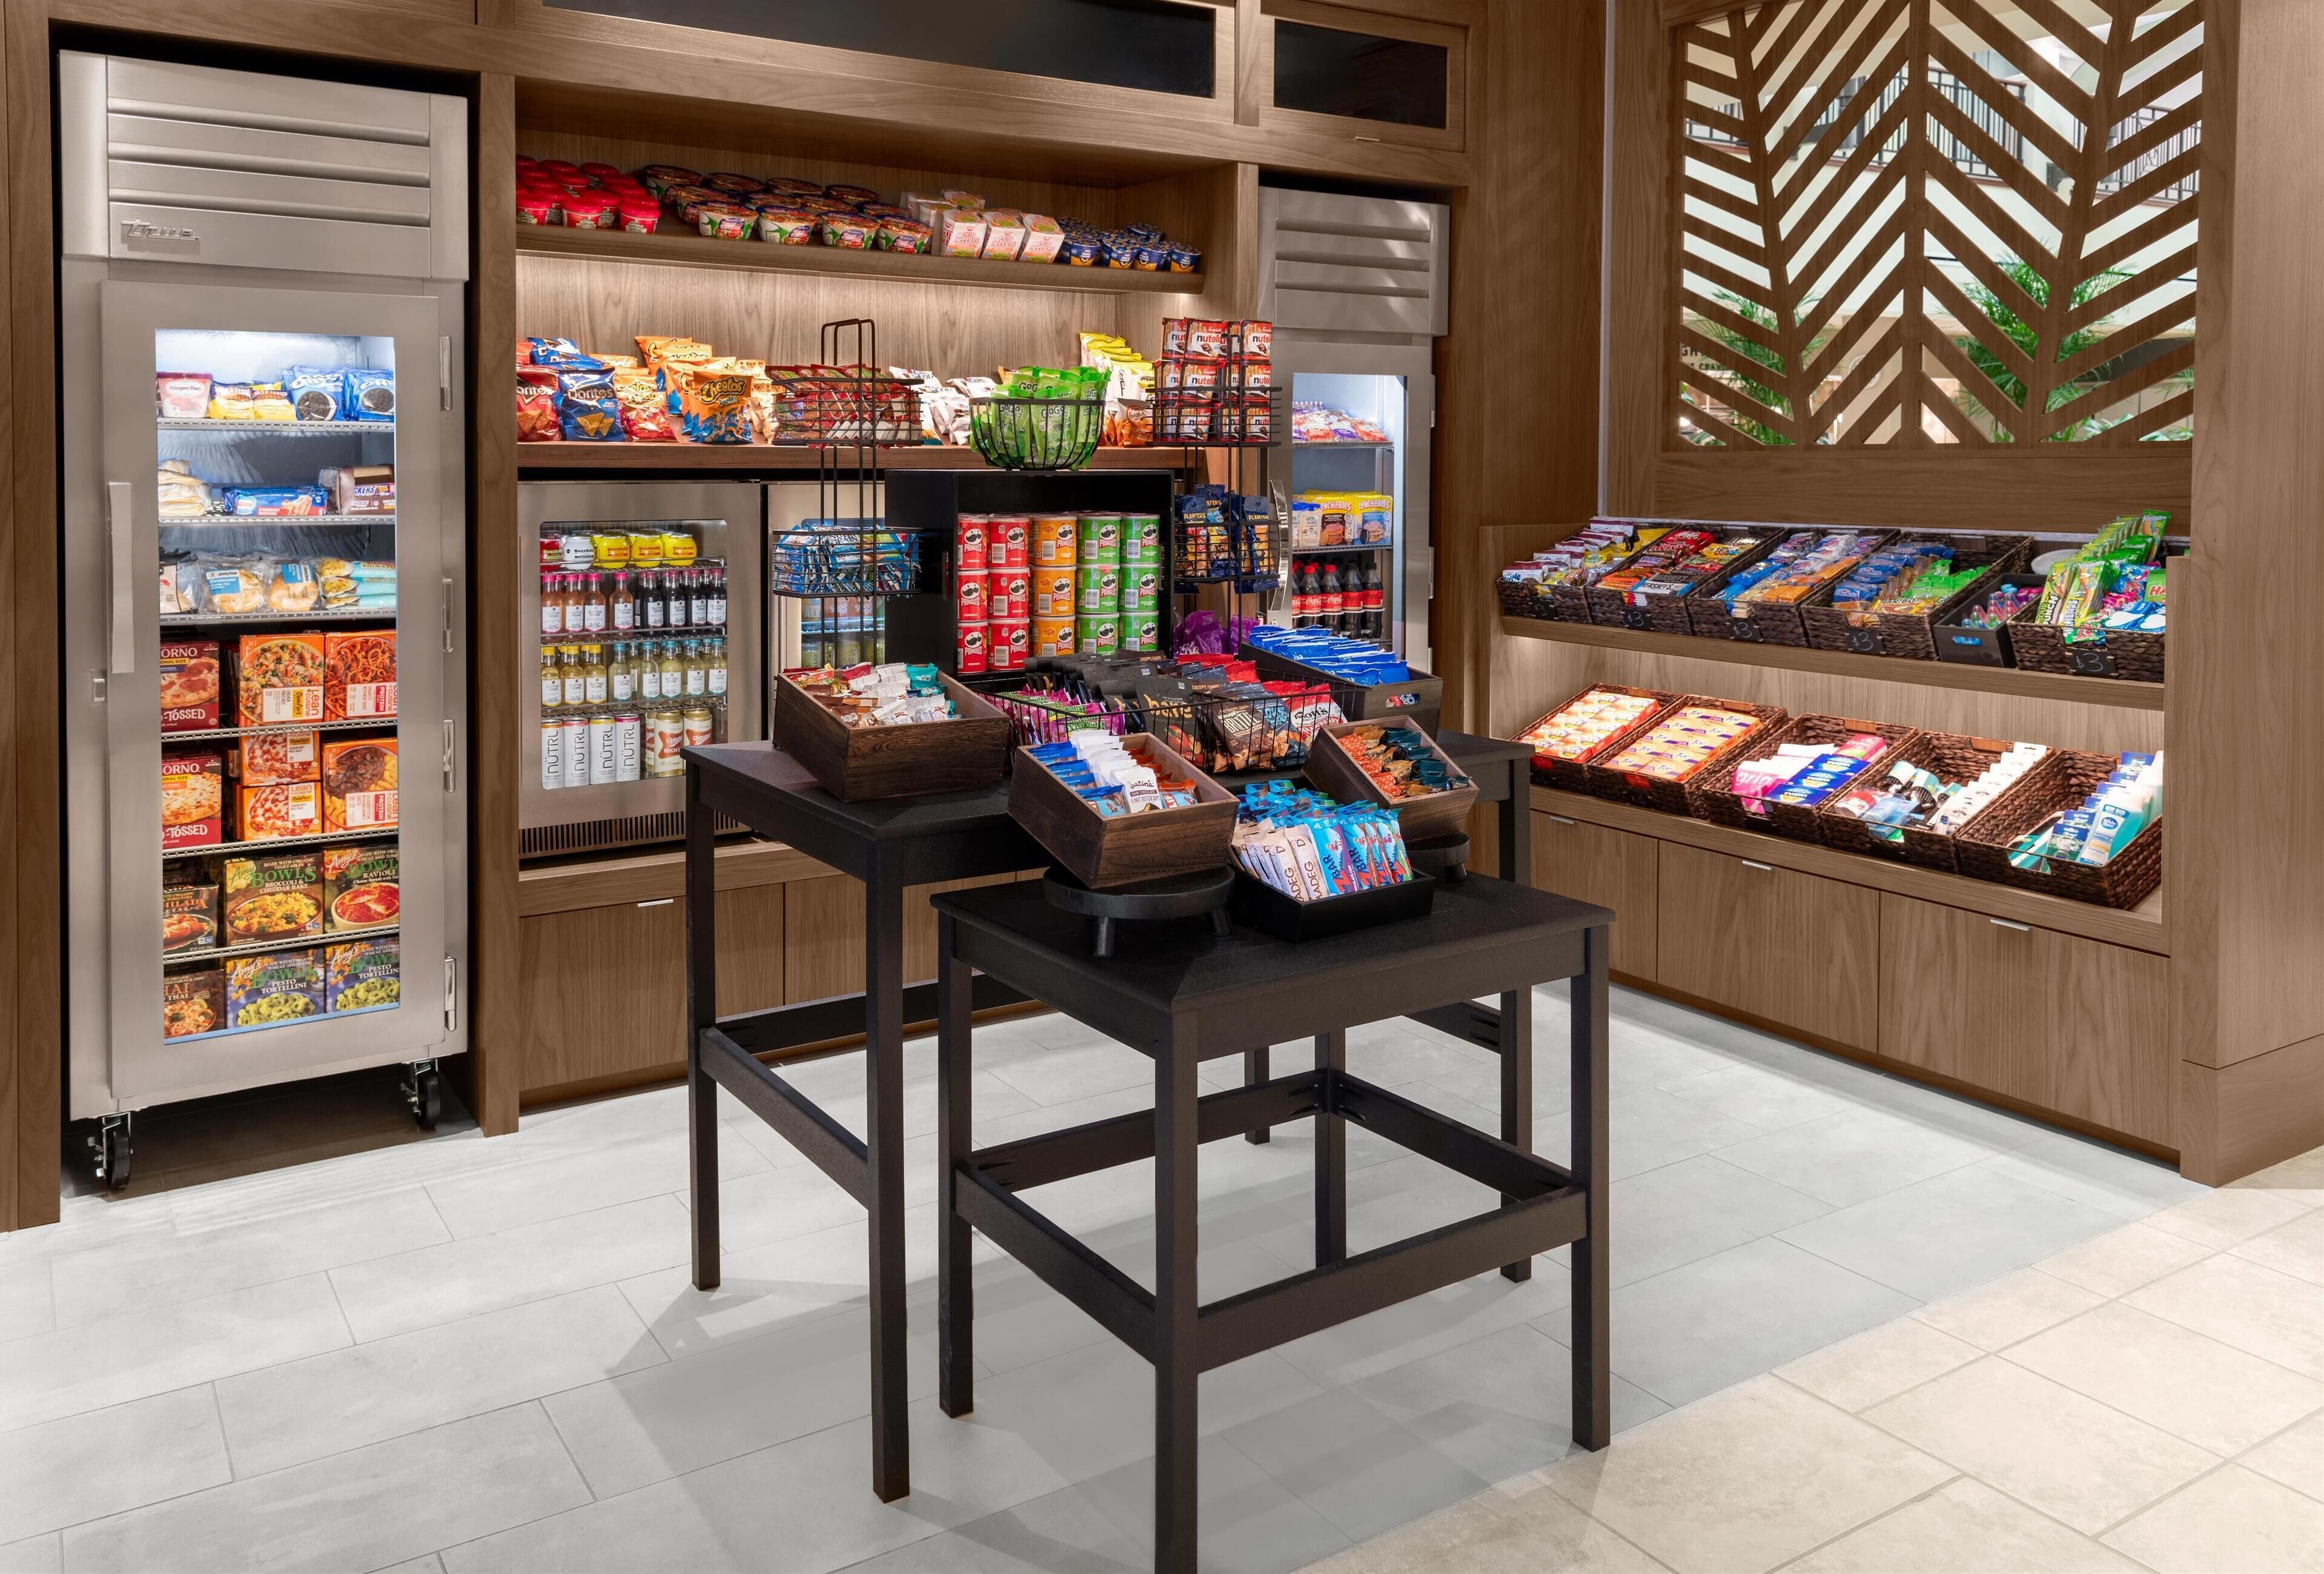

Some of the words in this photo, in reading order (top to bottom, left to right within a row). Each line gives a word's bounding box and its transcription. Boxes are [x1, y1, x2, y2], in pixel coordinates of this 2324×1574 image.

[568, 388, 614, 400] Doritos
[700, 375, 747, 404] Cheetos
[1129, 411, 1147, 419] Goldfish
[1359, 500, 1390, 510] LUNCHABLES
[964, 543, 982, 552] PRINGLES
[1007, 541, 1024, 551] PRINGLES
[1056, 539, 1074, 549] PRINGLES
[1099, 538, 1116, 548] PRINGLES
[1142, 538, 1157, 547] PRINGLES
[1641, 581, 1674, 590] HERSHEY'S
[1053, 592, 1071, 602] PRINGLES
[1101, 587, 1116, 598] PRINGLES
[1140, 587, 1156, 597] PRINGLES
[961, 597, 980, 607] PRINGLES
[1009, 594, 1025, 603] PRINGLES
[1733, 622, 1752, 638] $3
[1057, 641, 1073, 651] PRINGLES
[1097, 637, 1114, 647] PRINGLES
[1140, 636, 1156, 646] PRINGLES
[1851, 632, 1874, 651] $3
[965, 646, 982, 655] PRINGLES
[1010, 644, 1027, 653] PRINGLES
[2076, 653, 2104, 672] $3
[311, 688, 320, 716] Lean
[1144, 693, 1193, 719] bare
[1294, 707, 1329, 719] Mott's
[1127, 780, 1154, 789] Justin's
[290, 857, 316, 865] ORGANIC
[1323, 853, 1340, 878] BAR
[251, 865, 317, 888] BOWLS
[363, 870, 396, 879] RAVIOLI
[259, 885, 291, 893] CHEDDAR
[265, 880, 298, 888] BROCCOLI
[327, 945, 362, 970] Amy's
[227, 959, 262, 984] Amy's
[368, 964, 392, 973] PESTO
[272, 979, 296, 987] PESTO
[261, 982, 307, 995] TORTELLINI
[168, 993, 190, 1001] THAI
